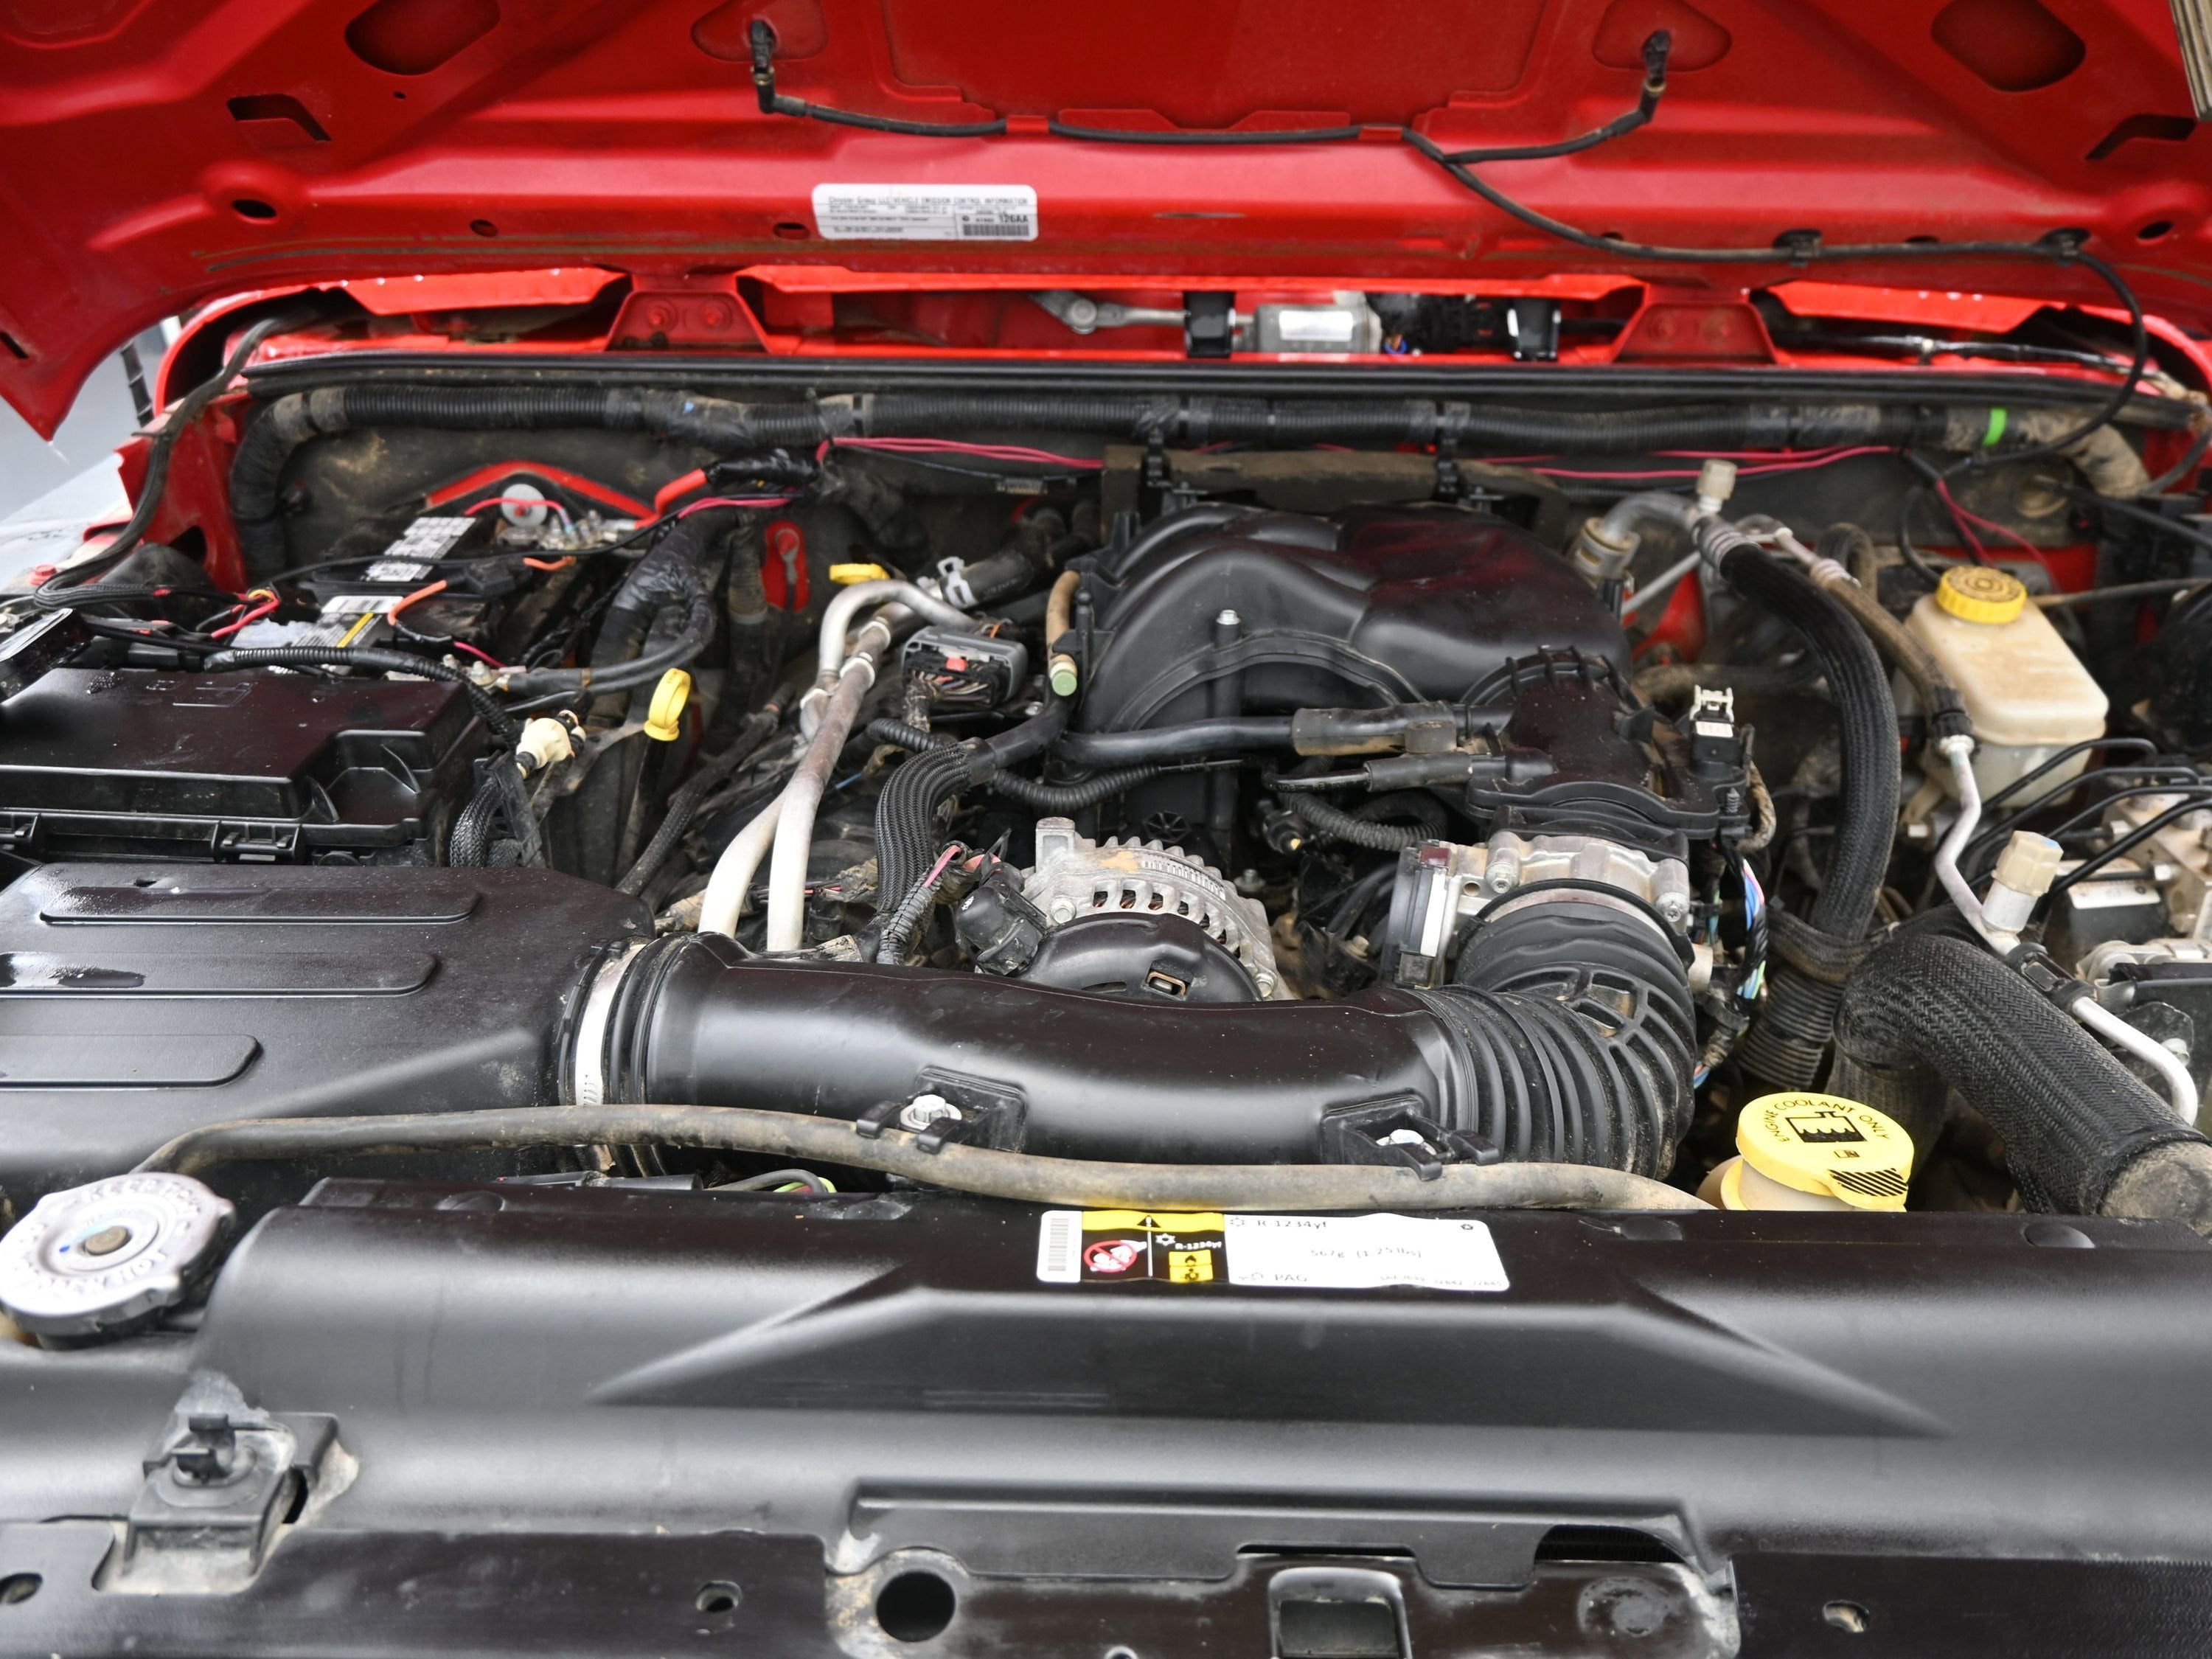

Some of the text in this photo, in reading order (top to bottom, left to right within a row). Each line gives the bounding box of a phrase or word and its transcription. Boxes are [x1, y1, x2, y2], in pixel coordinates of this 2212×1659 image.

[894, 196, 919, 204] VEHICLE
[921, 196, 951, 204] EMISSION
[984, 197, 1028, 205] INFORMATION
[1763, 1099, 1890, 1142] ENGINE COOLANT ONLY
[1274, 1273, 1308, 1282] PAG
